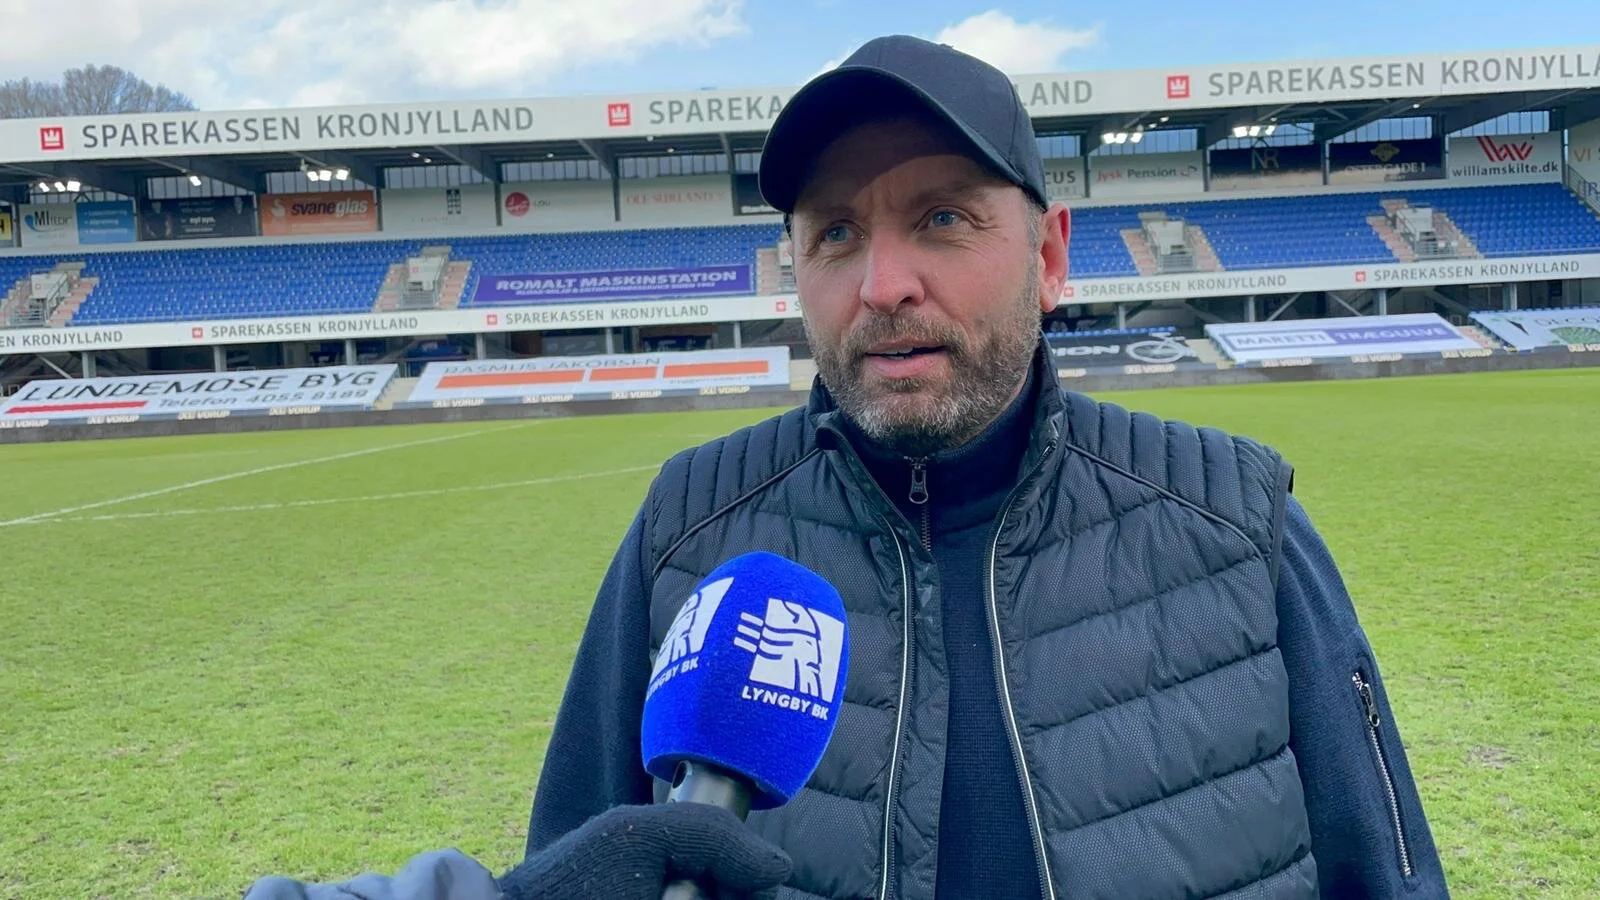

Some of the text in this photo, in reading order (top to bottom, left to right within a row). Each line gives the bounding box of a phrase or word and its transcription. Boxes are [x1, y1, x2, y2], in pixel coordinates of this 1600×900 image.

[1208, 62, 1425, 97] SPAREKASSEN
[649, 95, 785, 125] SPAREKA
[82, 106, 534, 148] SPAREKASSEN KRONJYLLAND
[1127, 165, 1177, 178] Pension
[1452, 160, 1559, 177] williamskilte.dk
[291, 199, 369, 217] svaneglas
[496, 278, 577, 291] ROMALT
[580, 271, 737, 288] MASKINSTATION
[1374, 260, 1580, 282] SPAREKASSEN KRONJYLLAND
[1082, 275, 1287, 297] SPAREKASSEN KRONJYLLAND
[505, 304, 709, 325] SPAREKASSEN KRONJYLLAND
[211, 317, 418, 338] SPAREKASSEN KRONJYLLAND
[22, 330, 123, 347] KRONJYLLAND
[20, 370, 379, 401] LUNDEMOSE BYG
[158, 395, 238, 408] Telefon
[680, 656, 699, 674] BK
[741, 686, 829, 721] LYNGBY BK
